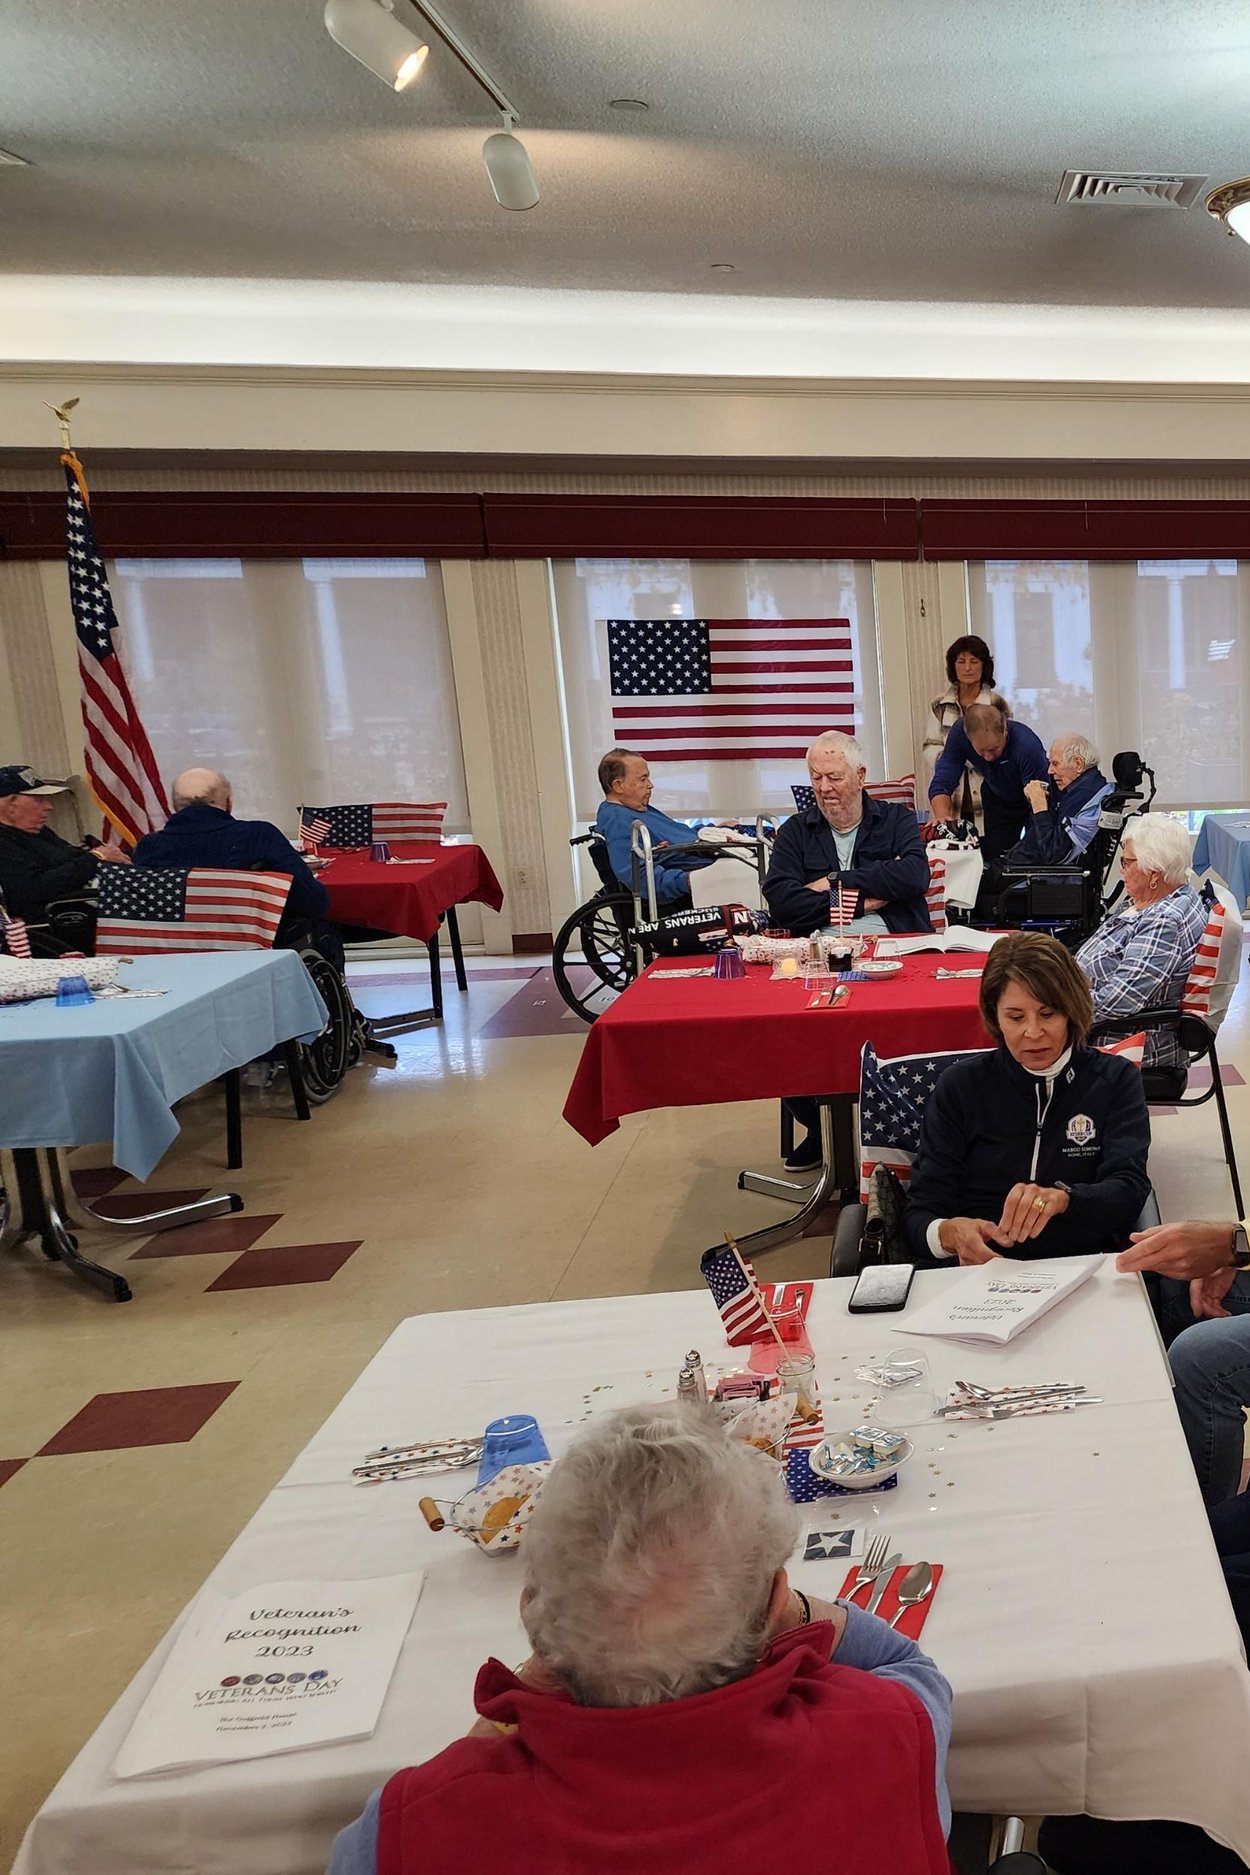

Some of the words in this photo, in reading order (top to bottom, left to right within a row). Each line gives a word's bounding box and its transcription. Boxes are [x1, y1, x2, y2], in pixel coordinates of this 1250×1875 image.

[638, 922, 659, 933] ARE
[665, 911, 721, 929] VETERANS
[250, 1608, 354, 1621] Veteran's
[224, 1624, 361, 1643] Recognition
[254, 1645, 314, 1657] 2023
[195, 1684, 297, 1701] VETERANS
[303, 1678, 343, 1693] DAY
